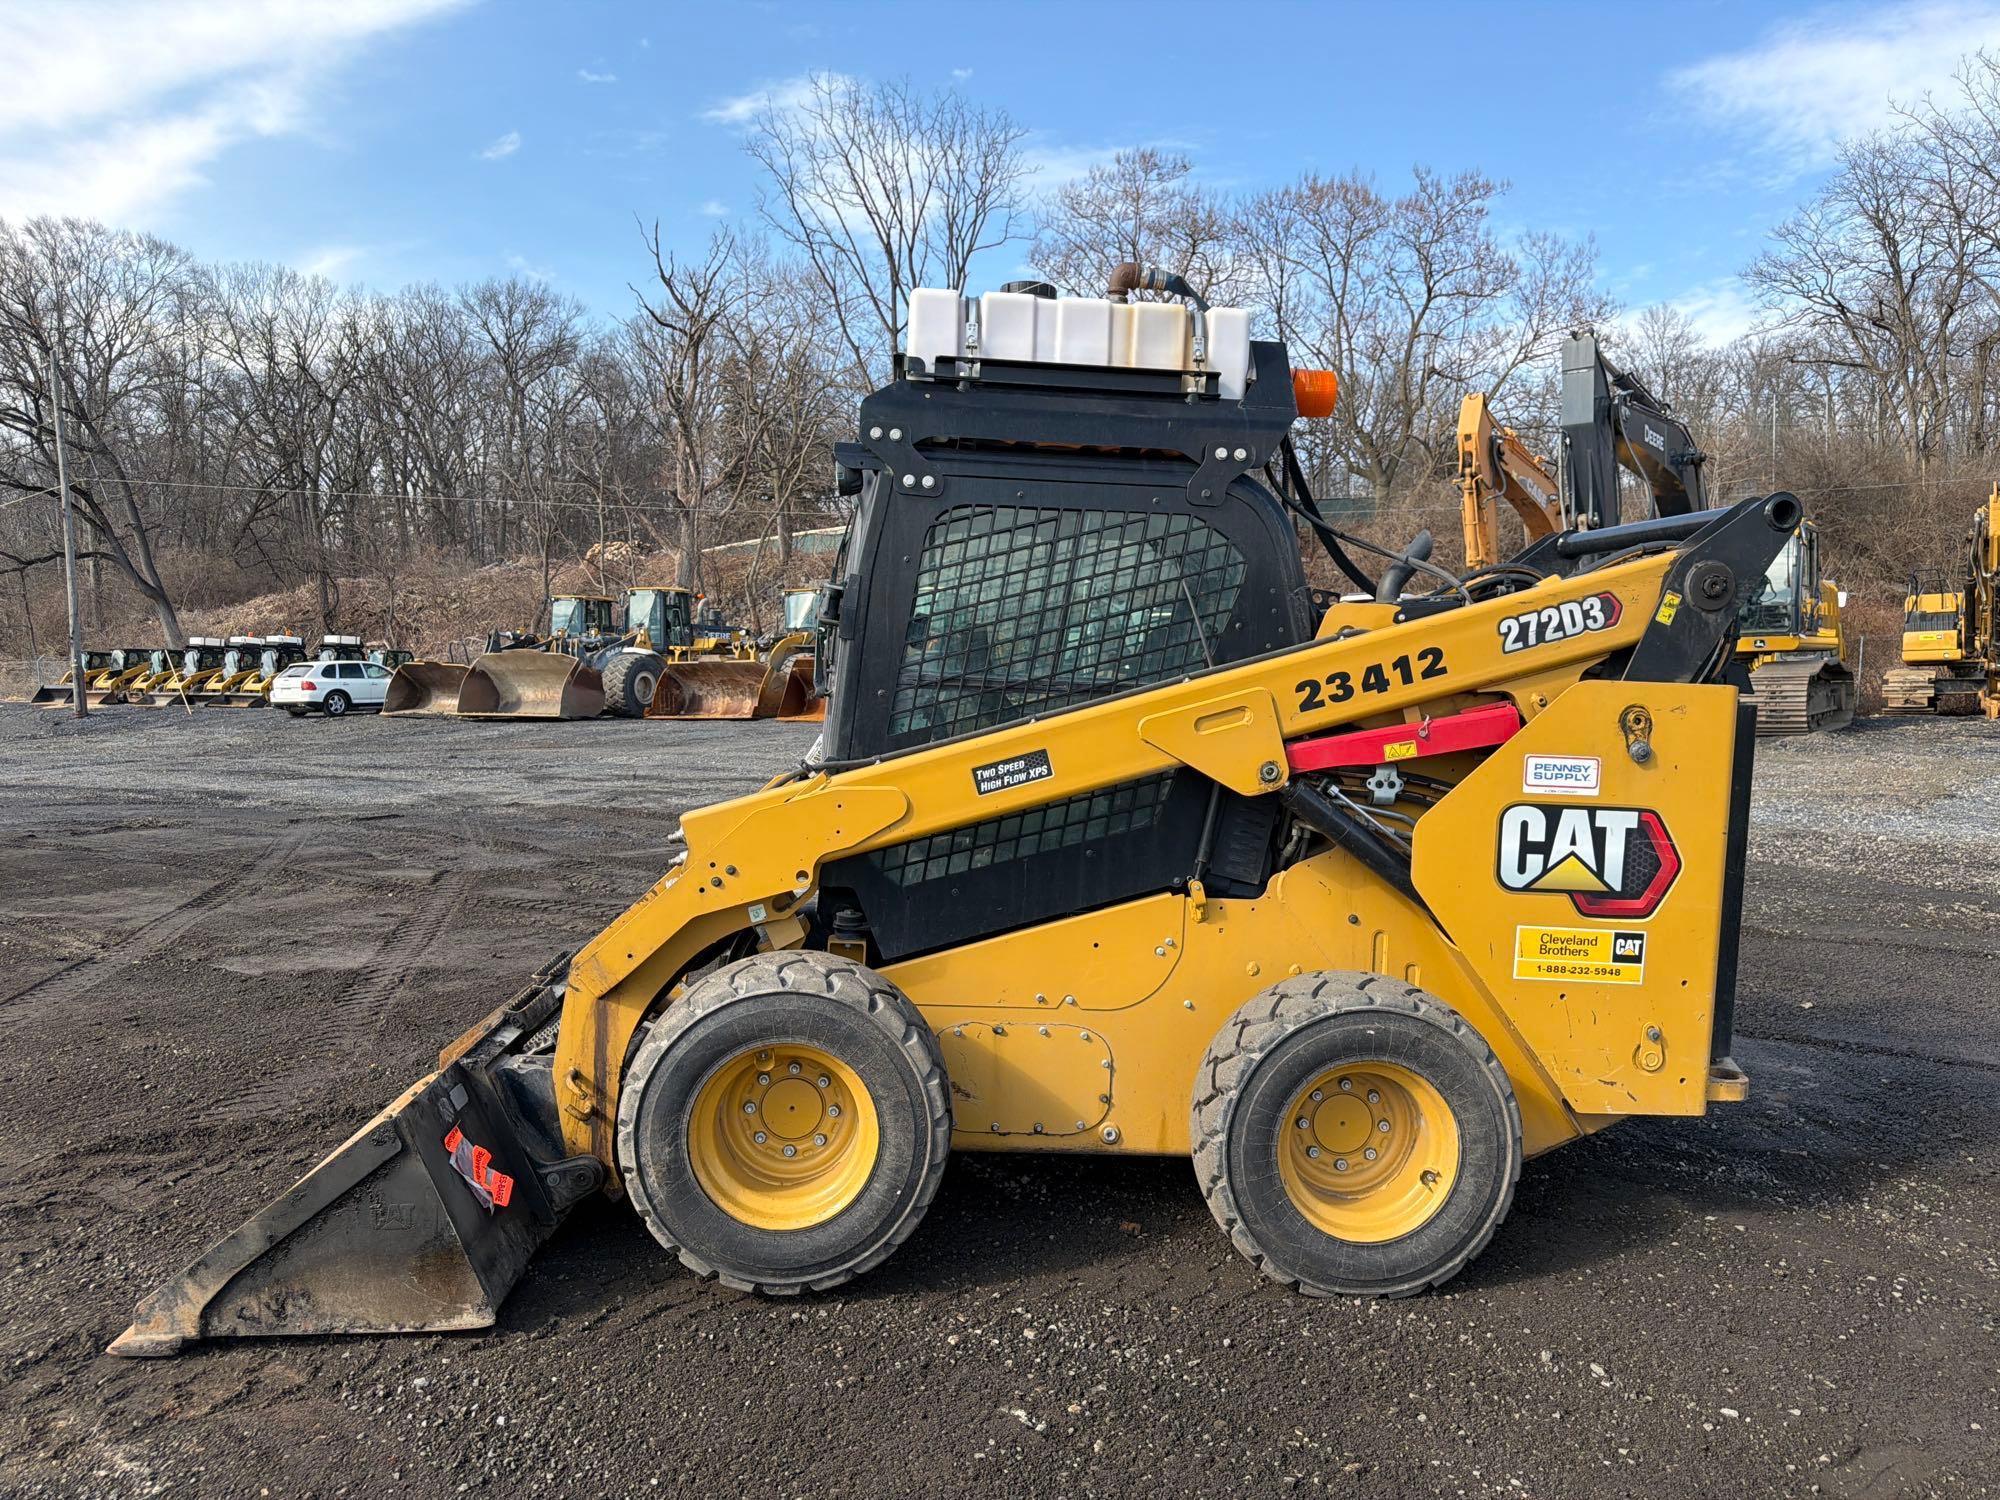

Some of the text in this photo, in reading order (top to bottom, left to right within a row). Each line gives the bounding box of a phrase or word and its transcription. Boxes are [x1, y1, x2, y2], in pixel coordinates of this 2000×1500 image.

[1644, 423, 1665, 451] DEERE
[1525, 477, 1548, 509] CASE
[1499, 596, 1605, 652] 272D3
[704, 631, 731, 640] DEERE
[1294, 646, 1448, 712] 23412
[1029, 765, 1048, 779] XPS
[1534, 763, 1592, 773] PENNSY
[1533, 772, 1592, 782] SUPPLY
[1500, 805, 1639, 892] CAT
[1540, 933, 1598, 947] Cleveland
[1615, 938, 1643, 956] CAT
[1539, 944, 1590, 957] Brothers
[1537, 965, 1621, 976] 1-888-232-5948
